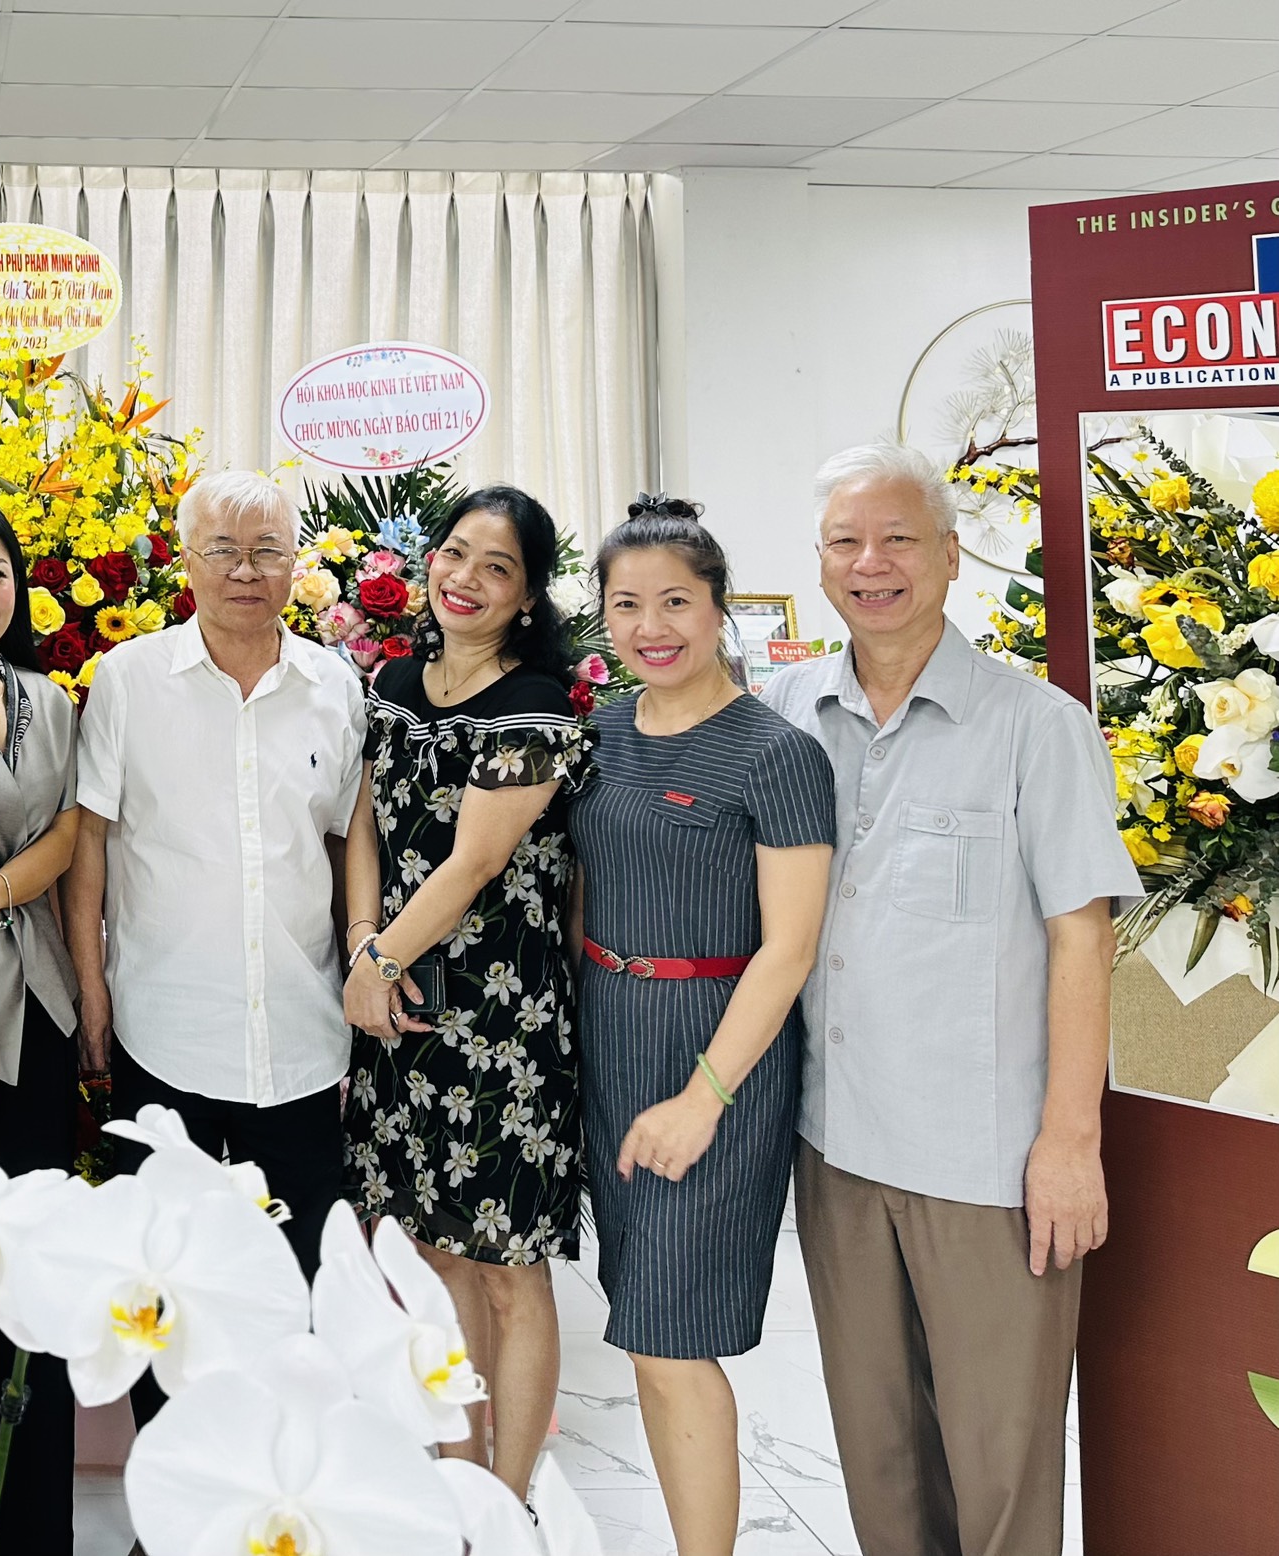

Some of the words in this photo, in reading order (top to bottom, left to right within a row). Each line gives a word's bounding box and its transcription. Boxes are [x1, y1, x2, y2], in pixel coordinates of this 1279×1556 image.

[1077, 214, 1117, 234] THE
[1130, 200, 1256, 229] INSIDER'S
[6, 245, 23, 272] PHỦ
[25, 253, 49, 277] PHẠM
[51, 254, 72, 273] MINH
[75, 250, 100, 273] CHÍNH
[3, 279, 20, 300] Chí
[23, 280, 47, 300] Kinh
[50, 277, 65, 300] Tế
[65, 279, 85, 306] Việt
[88, 280, 113, 300] Nam
[65, 305, 82, 334] Việt
[83, 306, 103, 328] Nam
[296, 382, 314, 407] HỘI
[317, 383, 345, 401] KHOA
[347, 381, 369, 403] HỌC
[370, 378, 396, 397] KINH
[398, 371, 412, 395] TẾ
[414, 371, 438, 396] VIỆT
[440, 372, 465, 390] NAM
[1109, 374, 1120, 387] A
[1132, 367, 1276, 386] PUBLICATION
[294, 417, 325, 442] CHÚC
[327, 416, 362, 440] MỪNG
[363, 411, 393, 436] NGÀY
[395, 409, 419, 433] BÁO
[422, 407, 442, 431] CHÍ
[444, 409, 473, 434] 21/6
[771, 646, 807, 656] Kinh
